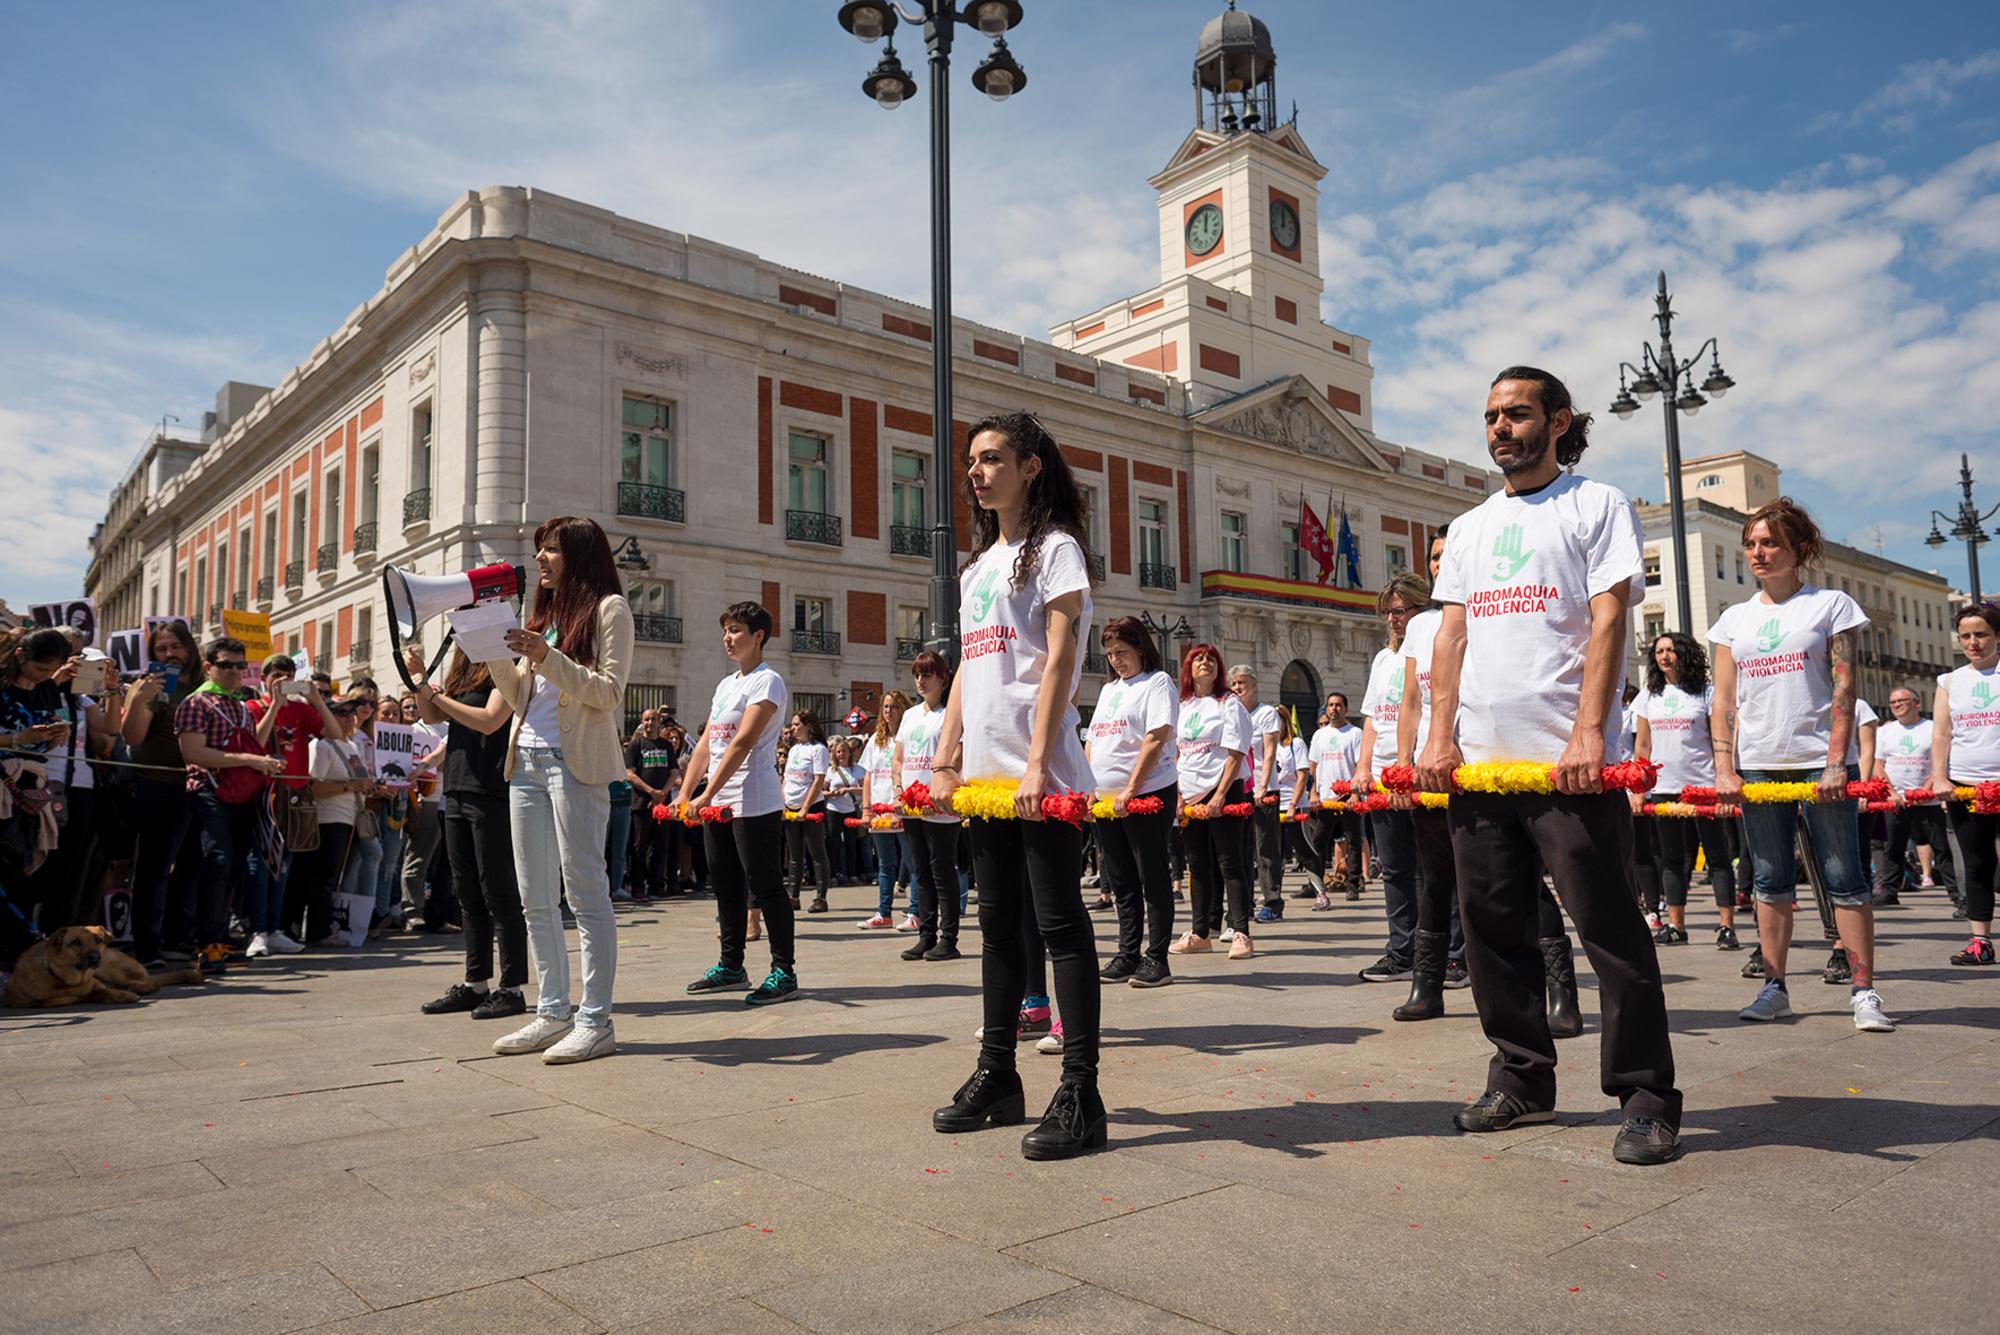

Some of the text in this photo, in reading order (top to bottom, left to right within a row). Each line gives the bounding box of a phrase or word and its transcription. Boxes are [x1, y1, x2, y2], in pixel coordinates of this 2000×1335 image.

[1466, 585, 1559, 608] AUROMAQUIA
[1472, 599, 1546, 617] VIOLENCIA
[1738, 650, 1809, 670] TAUROMAQUIA
[1748, 662, 1804, 677] VIOLENCIA
[376, 731, 413, 753] ABOLIR
